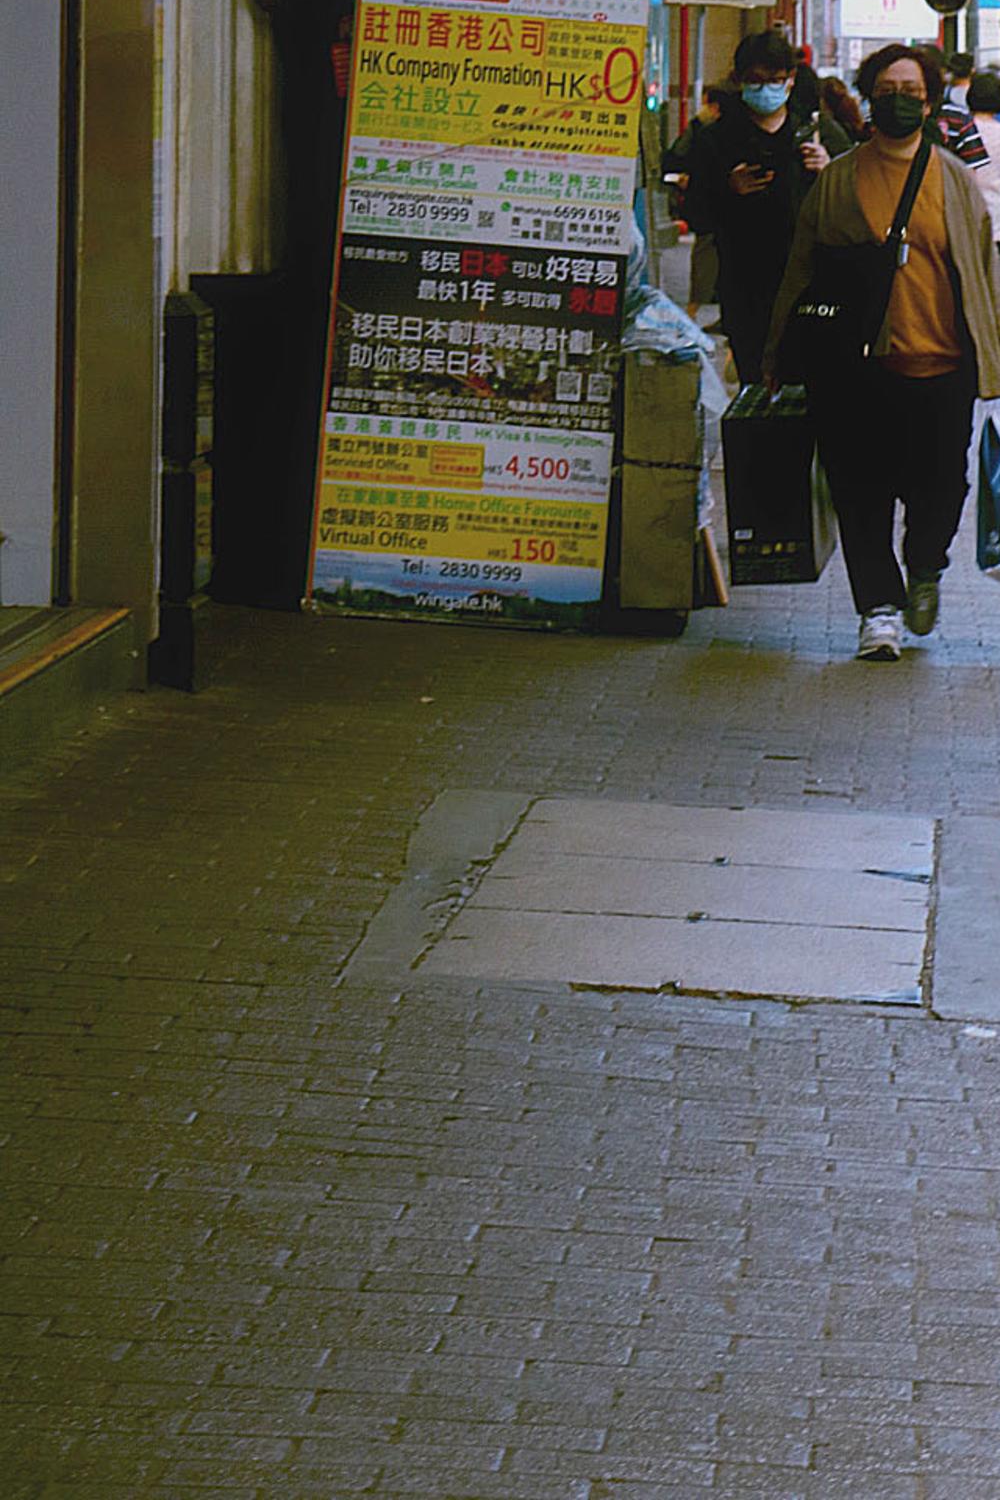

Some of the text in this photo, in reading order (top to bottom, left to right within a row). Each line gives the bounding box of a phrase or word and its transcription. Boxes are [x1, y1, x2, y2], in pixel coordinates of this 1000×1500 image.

[363, 6, 546, 57] 註冊香港公司
[359, 50, 543, 88] HK Company Formation
[360, 80, 482, 117] 会社設立
[491, 118, 629, 139] Company registration
[497, 182, 561, 199] Accounting
[349, 199, 470, 222] Tel: 2830 9999
[554, 205, 586, 219] 6699
[589, 208, 622, 223] 6196
[495, 428, 520, 441] Visa
[325, 455, 410, 471] Serviced Office
[505, 454, 571, 481] 4,500
[434, 495, 592, 518] Home Office Favourite
[320, 527, 428, 550] Virtual Office
[511, 538, 556, 563] 150
[401, 558, 431, 576] Tel:
[439, 561, 480, 579] 2830
[482, 564, 523, 582] 9999
[415, 593, 502, 613] wingate.hk
